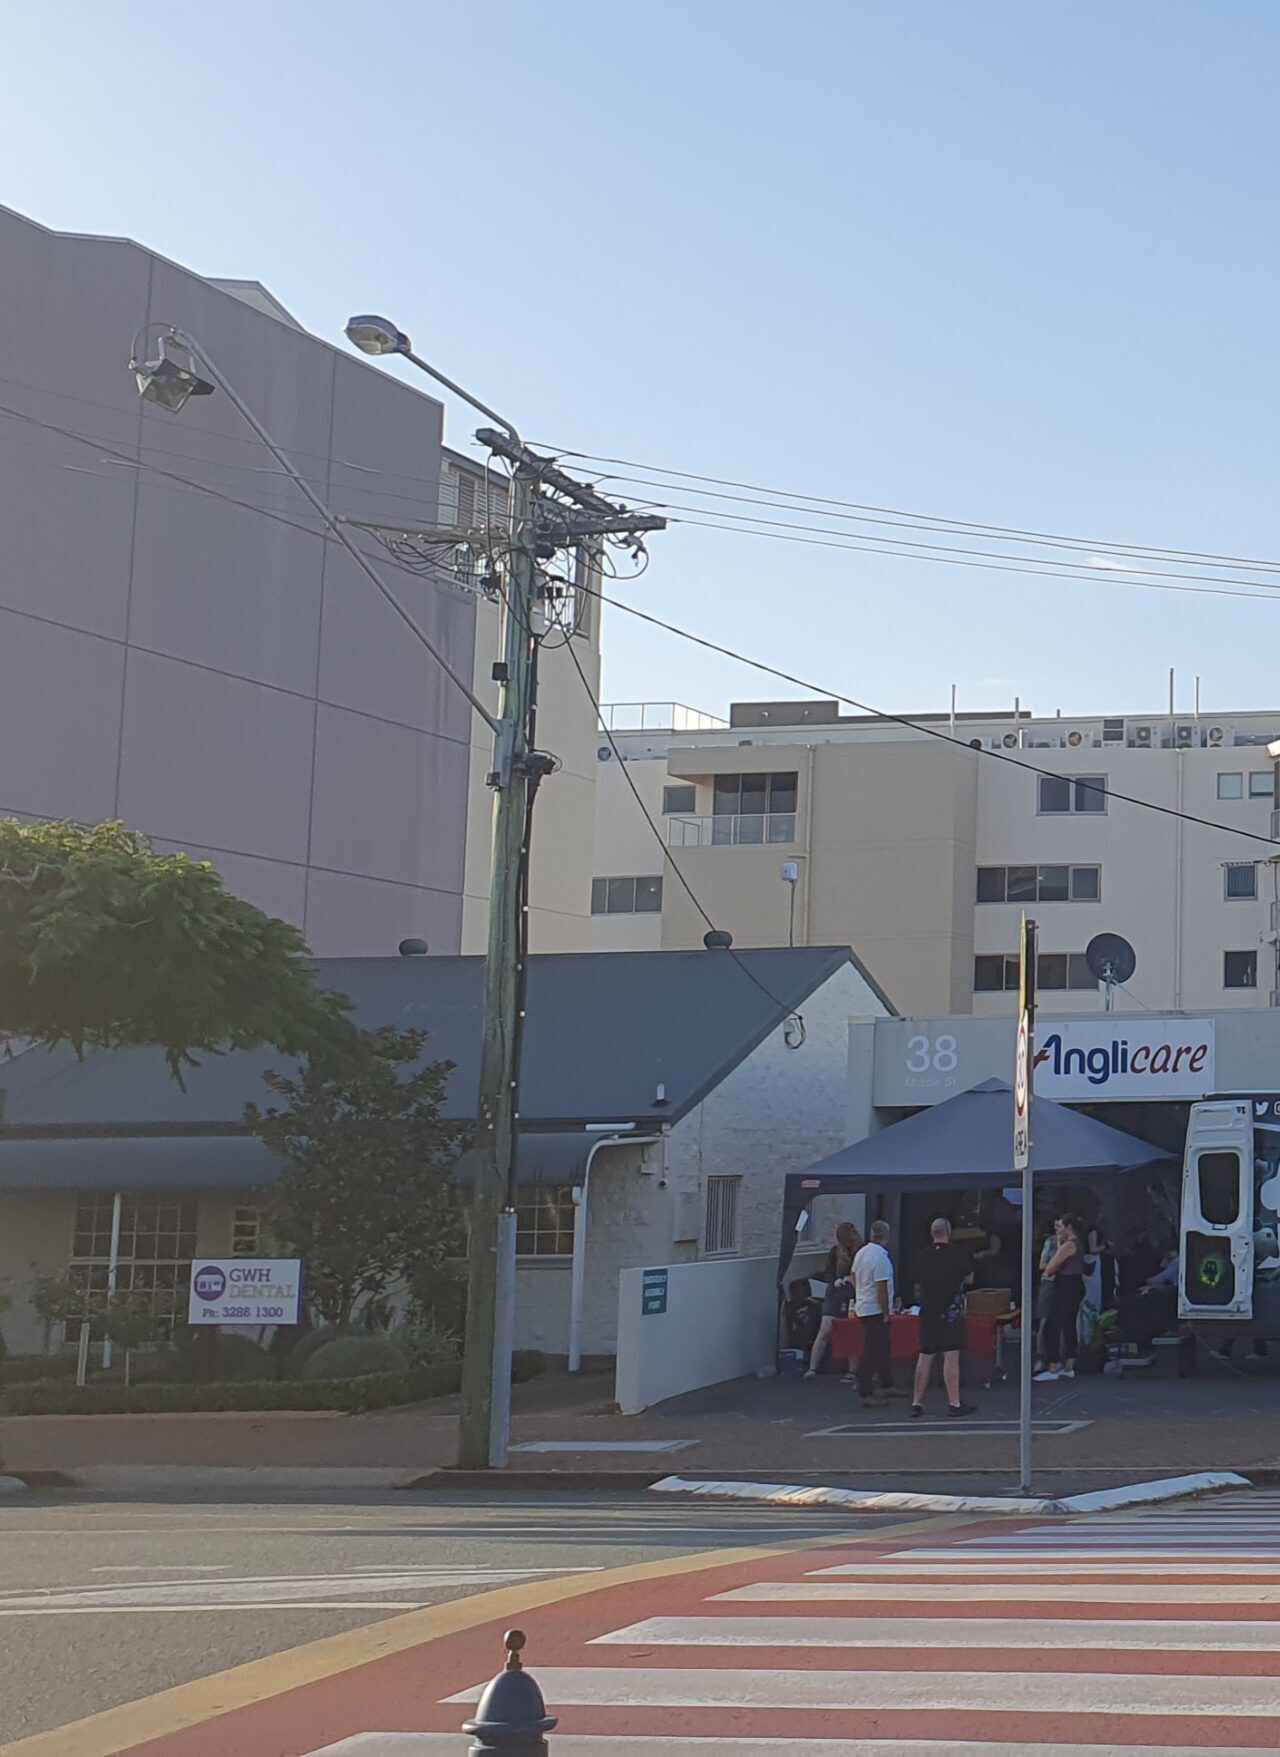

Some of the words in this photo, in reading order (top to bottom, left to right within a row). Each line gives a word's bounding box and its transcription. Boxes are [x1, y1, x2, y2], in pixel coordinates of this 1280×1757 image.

[905, 1034, 958, 1073] 38
[1033, 1033, 1208, 1084] Anglicare
[229, 1268, 271, 1282] GWH
[229, 1285, 295, 1298] DENTAL
[222, 1306, 251, 1318] 3286
[255, 1306, 283, 1318] 1300
